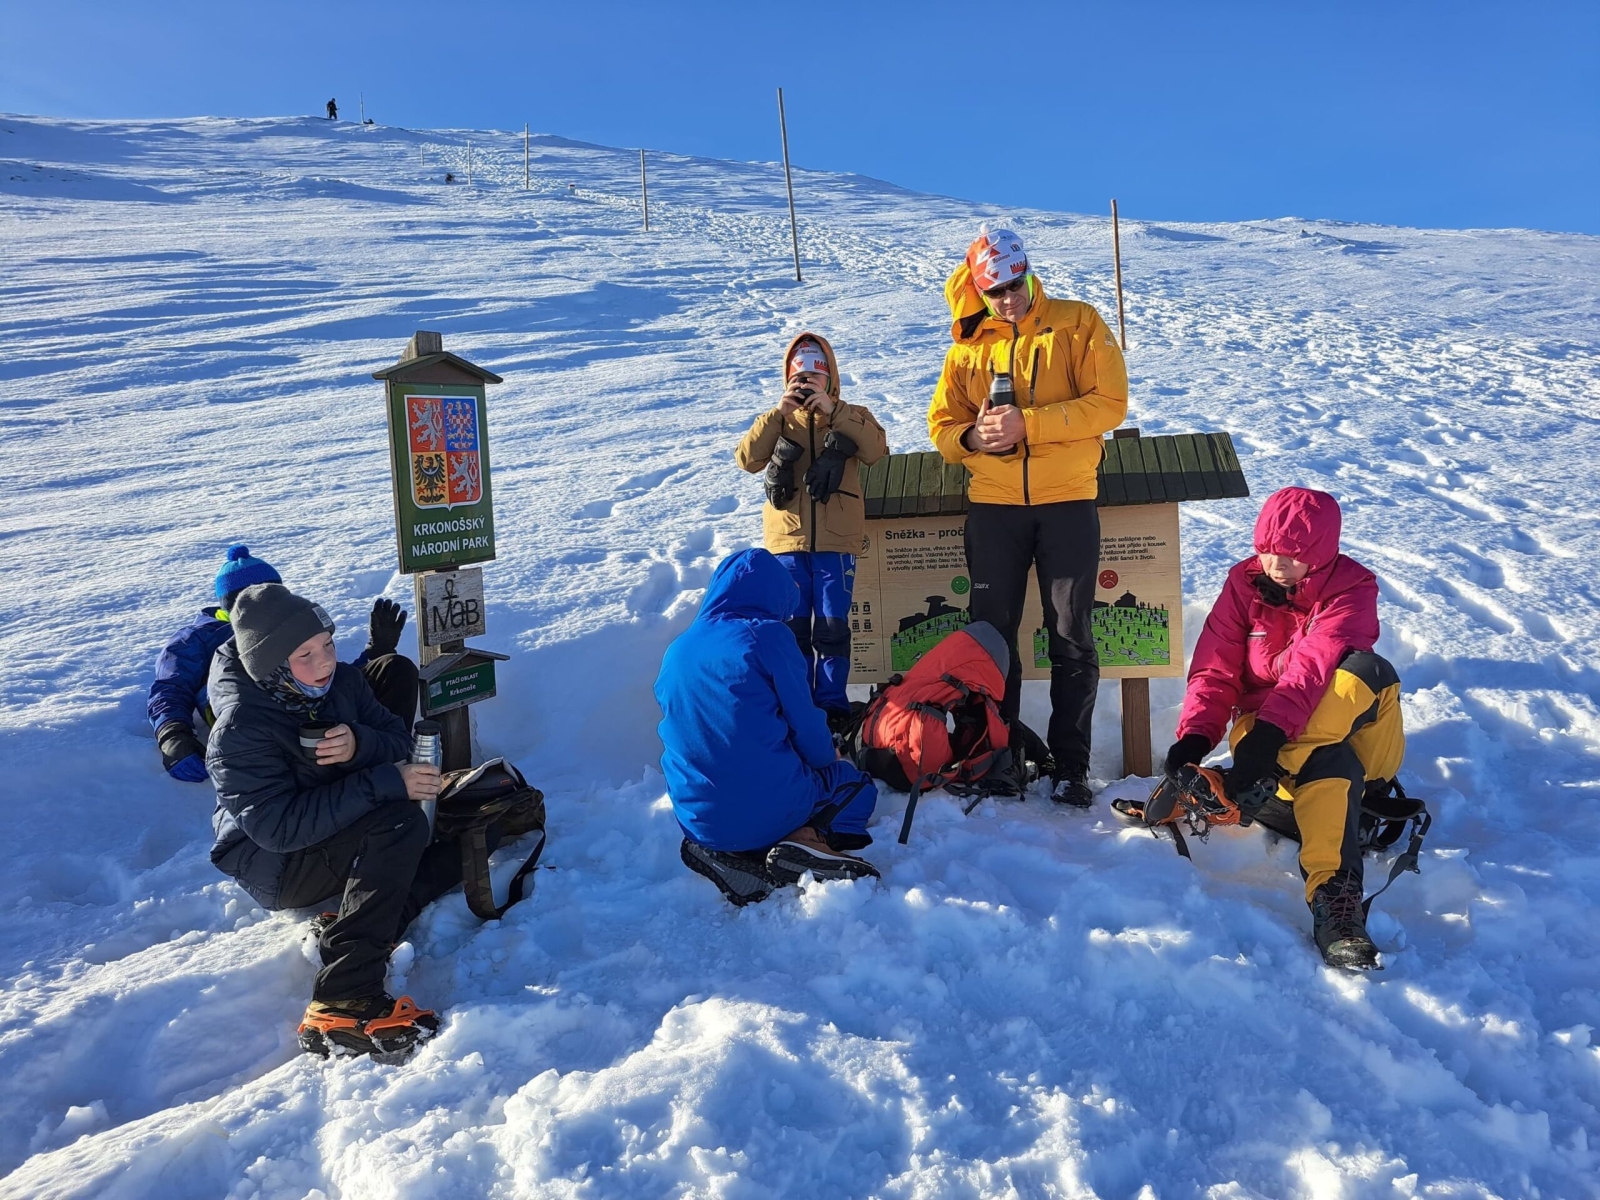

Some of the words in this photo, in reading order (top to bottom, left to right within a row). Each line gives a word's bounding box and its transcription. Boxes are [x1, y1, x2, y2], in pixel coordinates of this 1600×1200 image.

[413, 515, 485, 536] KRKONOŠSKÝ
[885, 529, 925, 540] Sněžka
[938, 527, 964, 539] proč
[412, 537, 460, 557] NÁRODNÍ
[462, 536, 489, 550] PARK
[446, 676, 460, 686] PTAČÍ
[461, 672, 478, 682] OBLAST
[450, 684, 476, 696] Krkonoše
